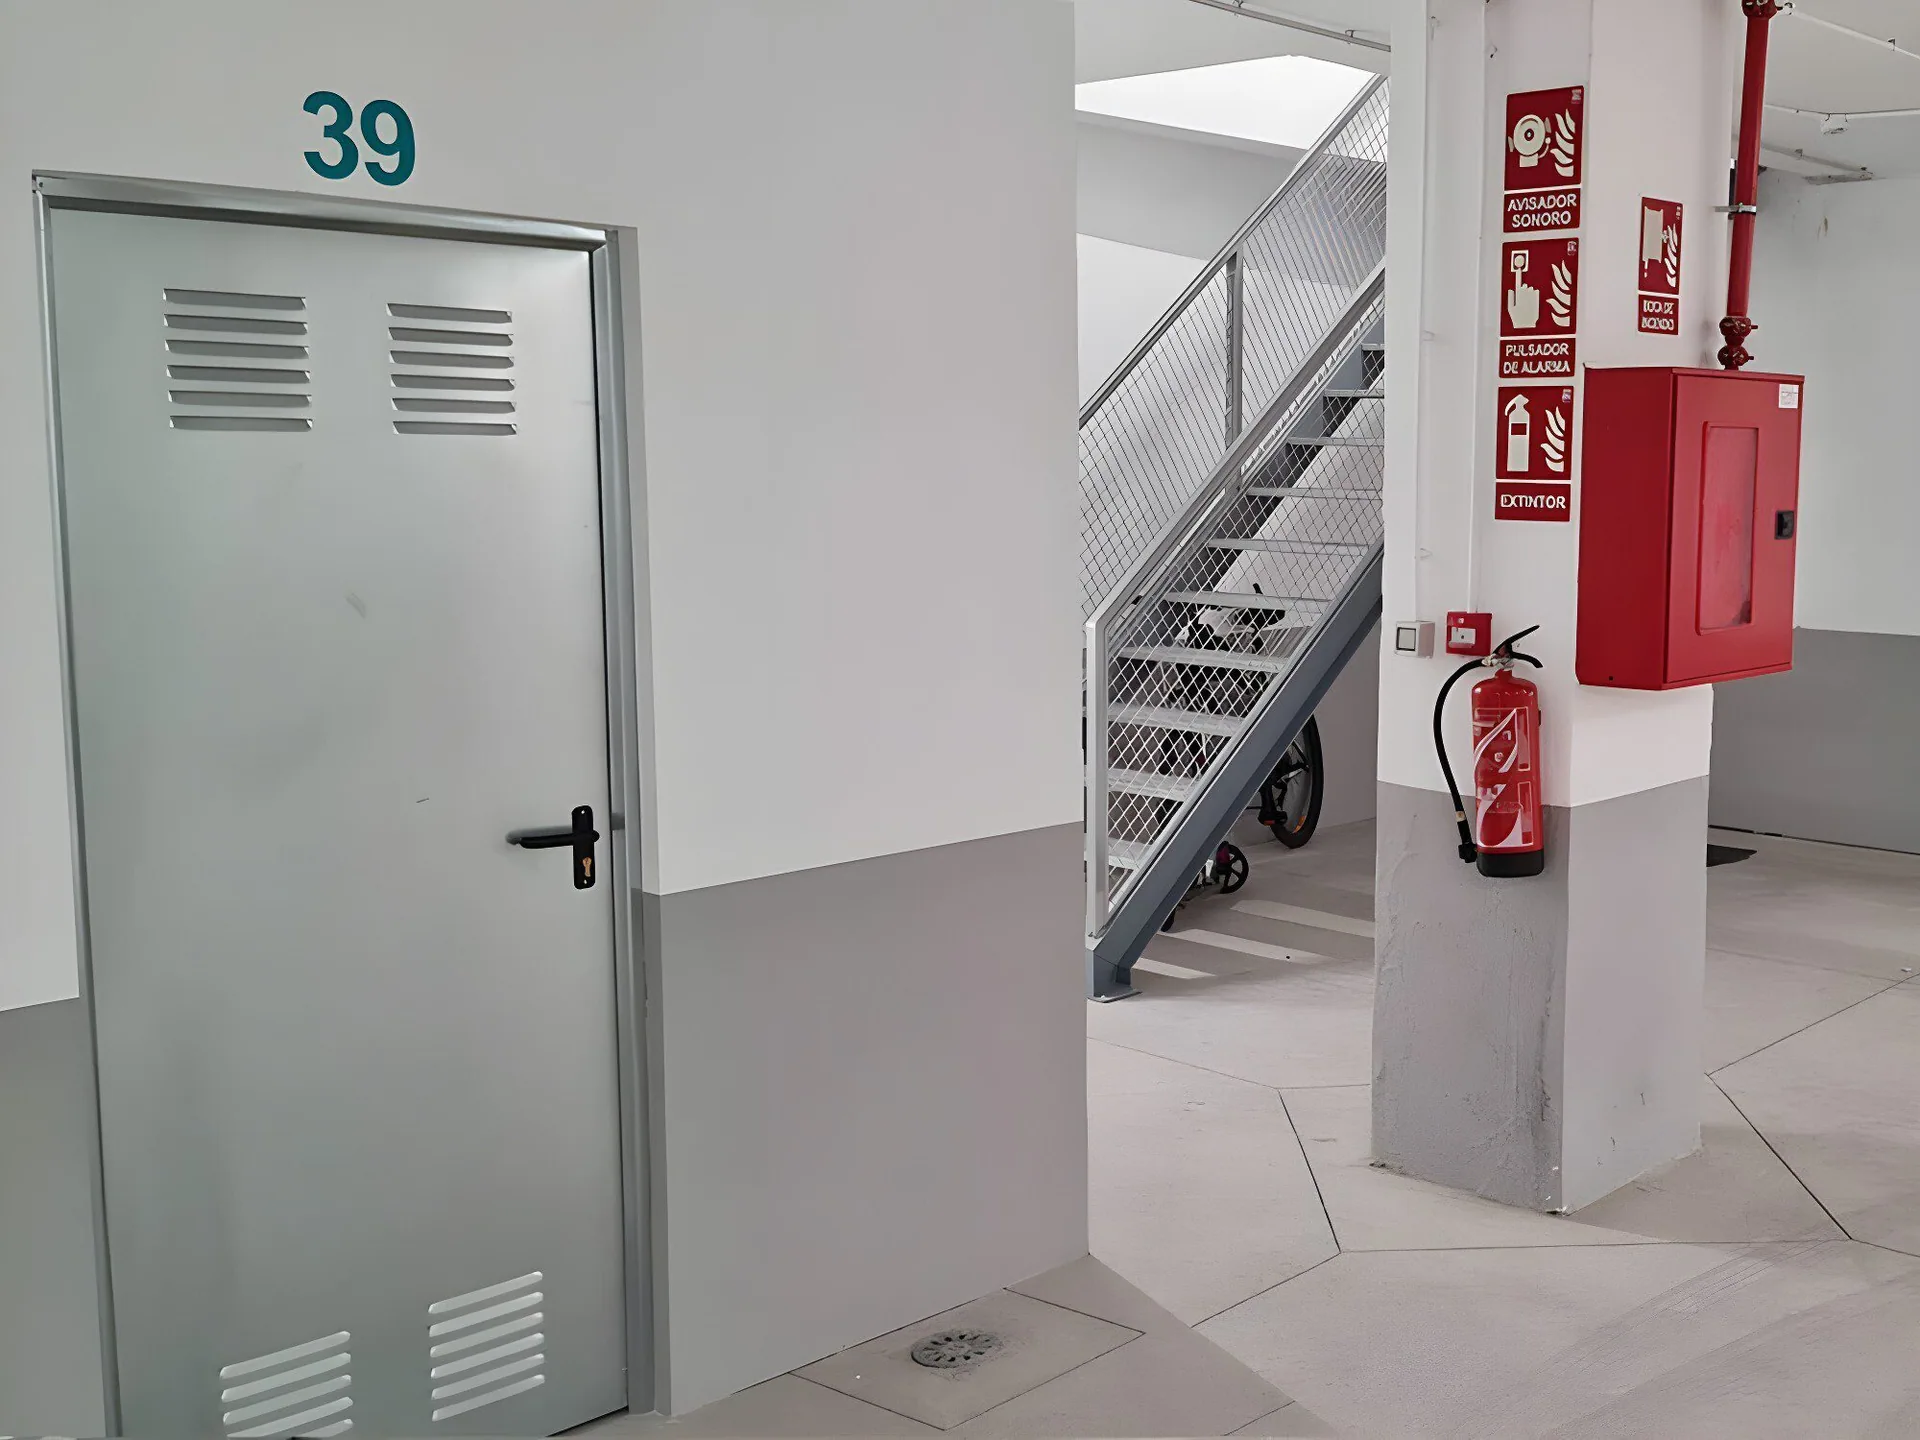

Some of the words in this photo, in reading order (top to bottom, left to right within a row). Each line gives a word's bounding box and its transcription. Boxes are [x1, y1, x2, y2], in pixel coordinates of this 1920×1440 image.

[303, 91, 415, 186] 39
[1507, 193, 1577, 212] AVISADOR
[1512, 210, 1571, 228] SONORO
[1505, 342, 1570, 357] PULSADOR
